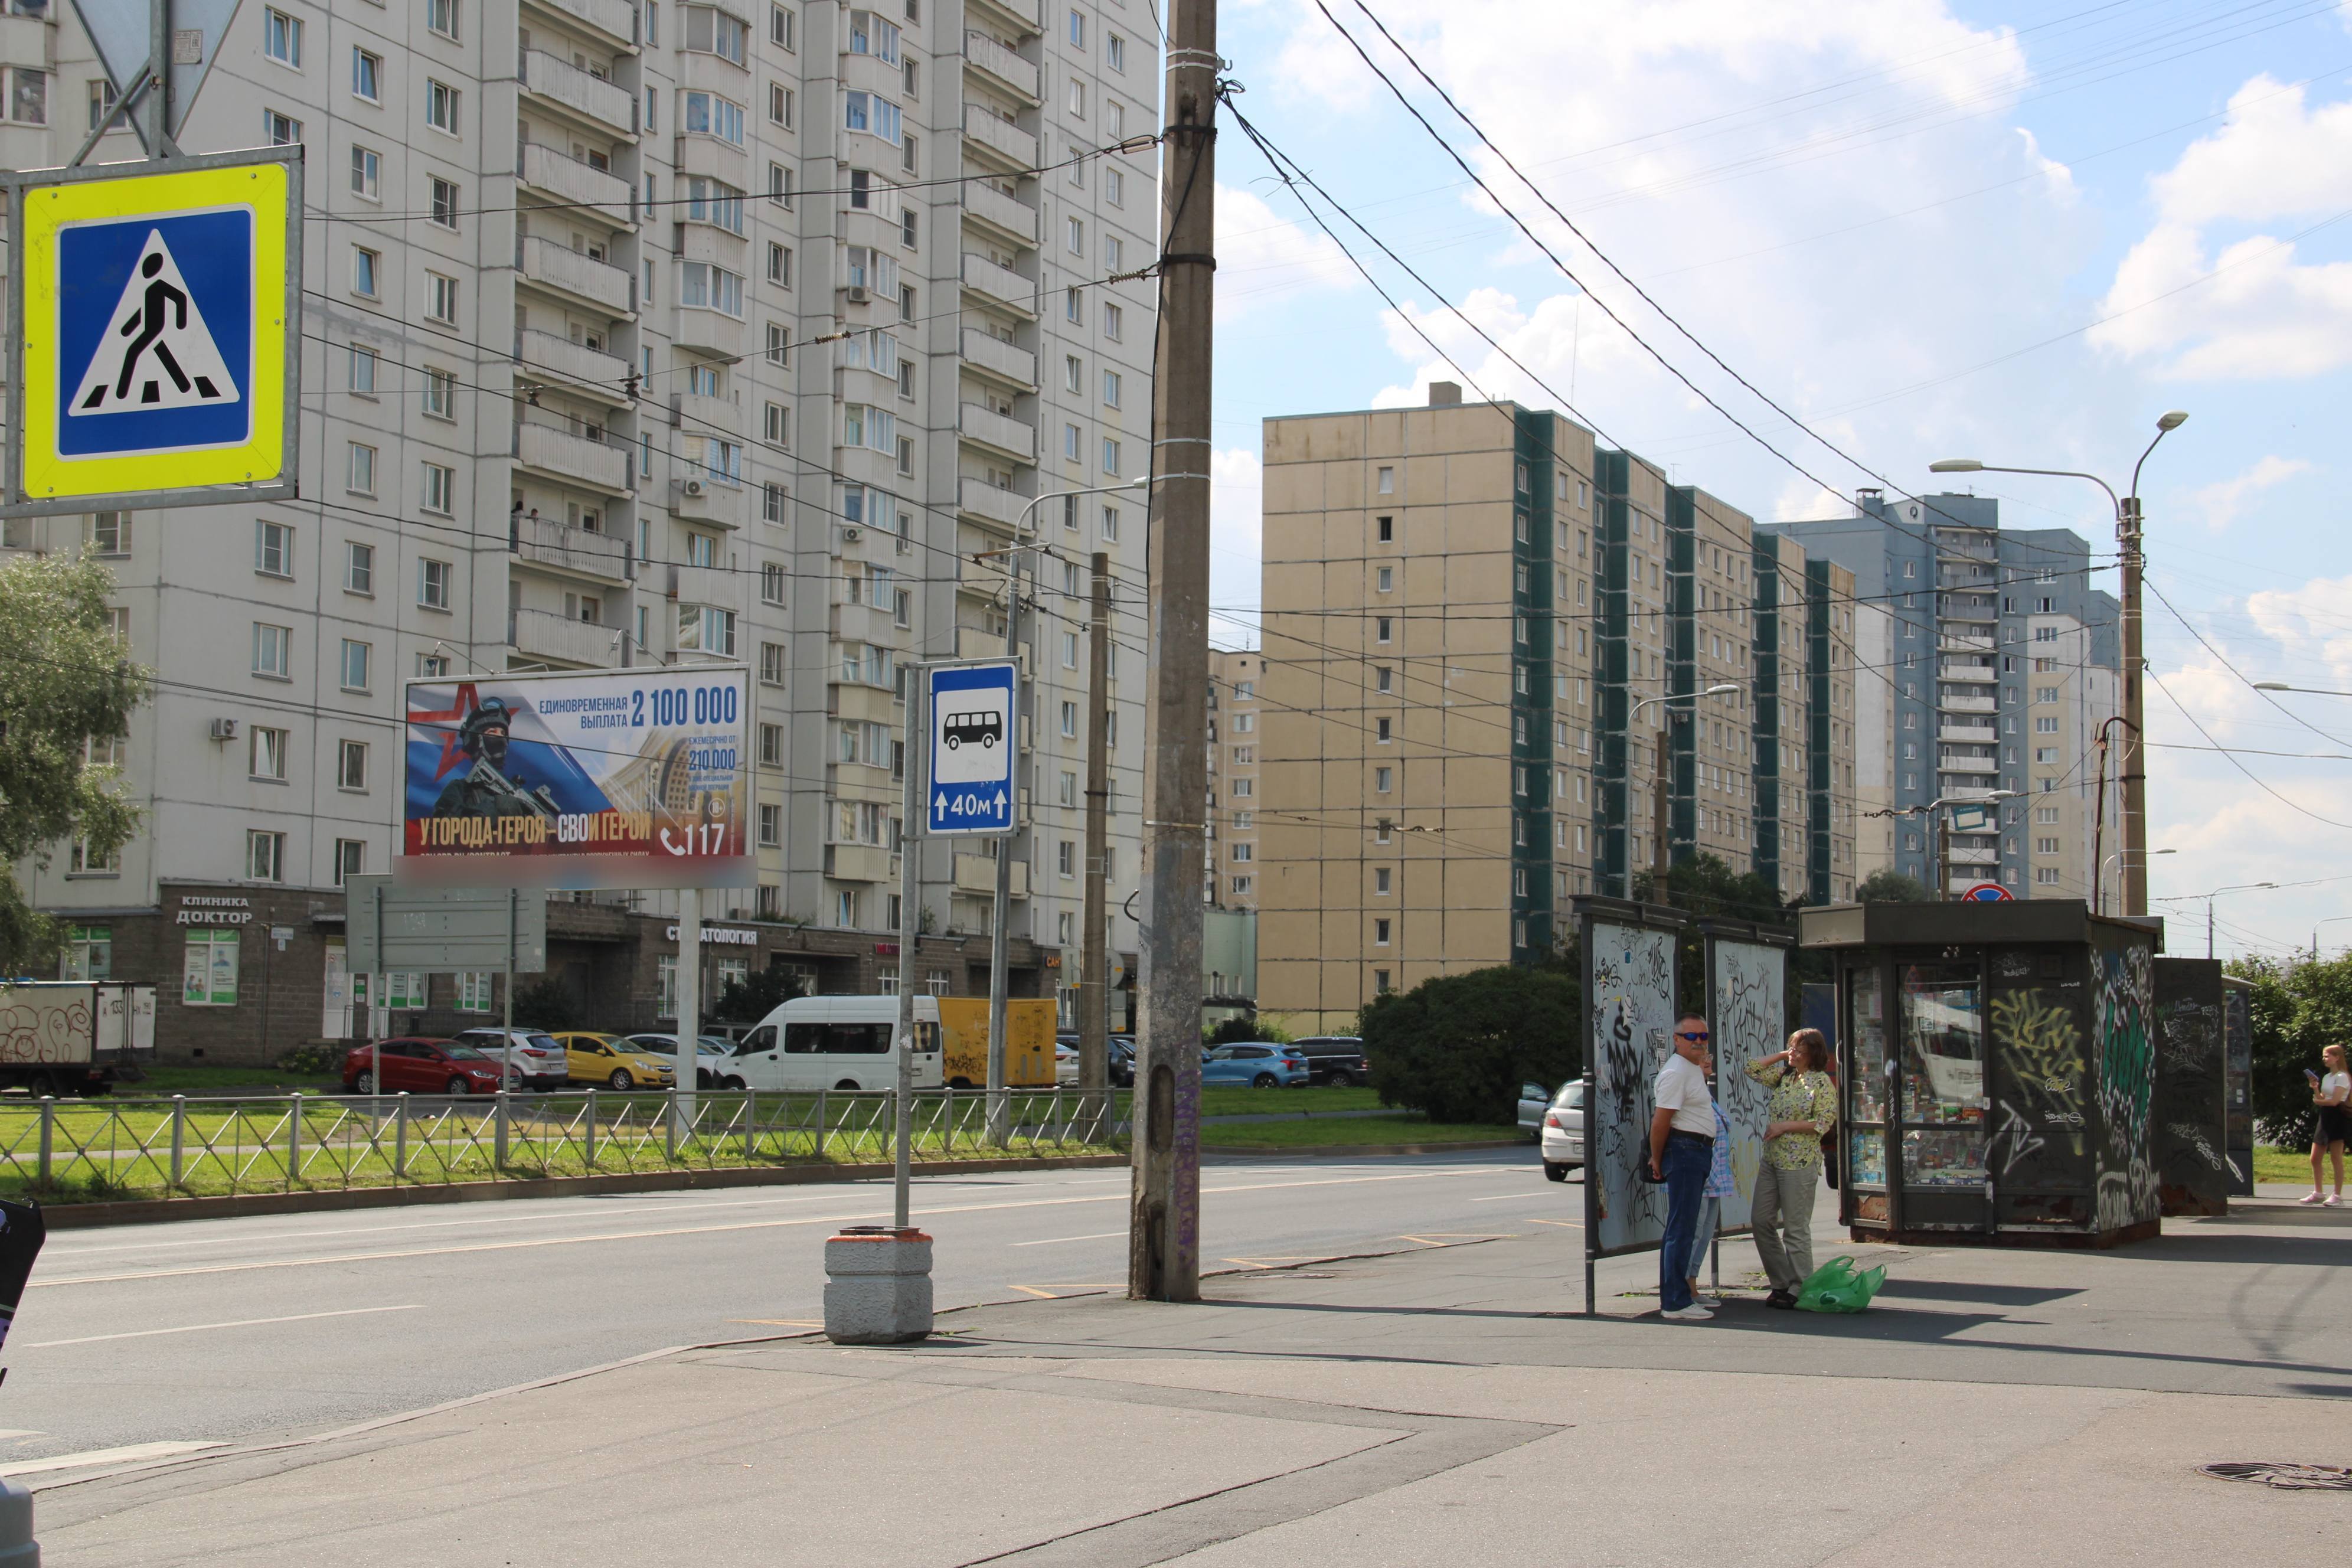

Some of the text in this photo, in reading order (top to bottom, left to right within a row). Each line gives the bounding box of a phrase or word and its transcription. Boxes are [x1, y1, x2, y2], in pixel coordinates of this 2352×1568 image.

[540, 697, 628, 714] ЕДИНОВРЕМЕННАЯ
[632, 686, 736, 727] 2 100 000
[581, 714, 628, 729] ВЫПЛАТА
[690, 736, 736, 744] ЕЖЕМЕСЯЧНО ОТ
[689, 749, 736, 771] 210 000
[712, 802, 723, 813] 18+
[420, 818, 429, 845] У
[432, 816, 545, 848] ГОРОДА-ГЕРОЯ
[558, 814, 600, 842] СВОИ
[602, 812, 650, 840] ГЕРОИ
[685, 824, 724, 855] 117
[182, 896, 249, 907] КЛИНИКА
[176, 910, 252, 924] ДОКТОР
[666, 926, 757, 945] СТАТОЛОГИЯ
